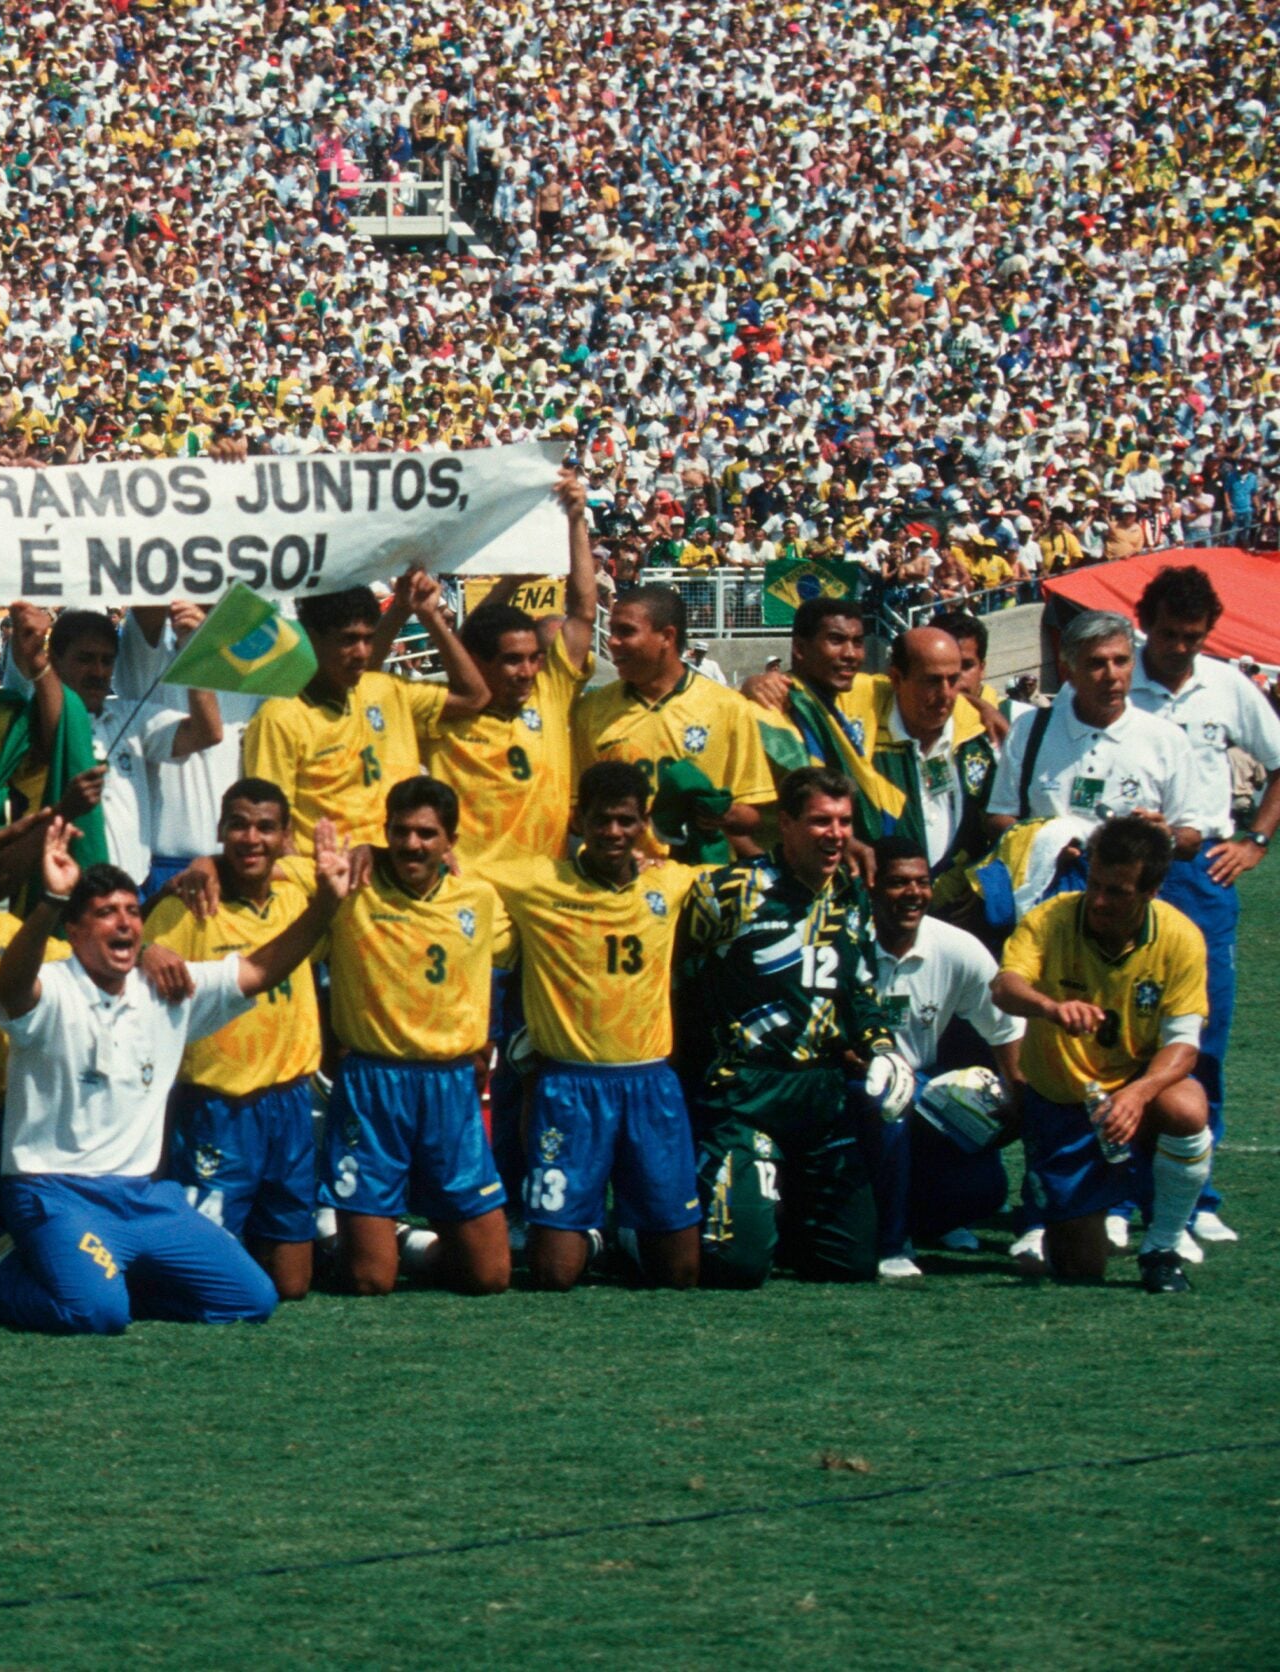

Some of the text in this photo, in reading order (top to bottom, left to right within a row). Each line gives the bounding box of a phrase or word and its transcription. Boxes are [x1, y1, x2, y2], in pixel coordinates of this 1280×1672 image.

[236, 456, 468, 514] JUNTOS,
[20, 524, 63, 597] É
[86, 532, 328, 596] NOSSO!
[507, 745, 532, 782] 9
[424, 943, 448, 985] 3
[604, 933, 644, 976] 13
[801, 945, 840, 990] 12
[335, 1155, 359, 1198] 3
[531, 1167, 568, 1212] 13
[753, 1160, 781, 1201] 12
